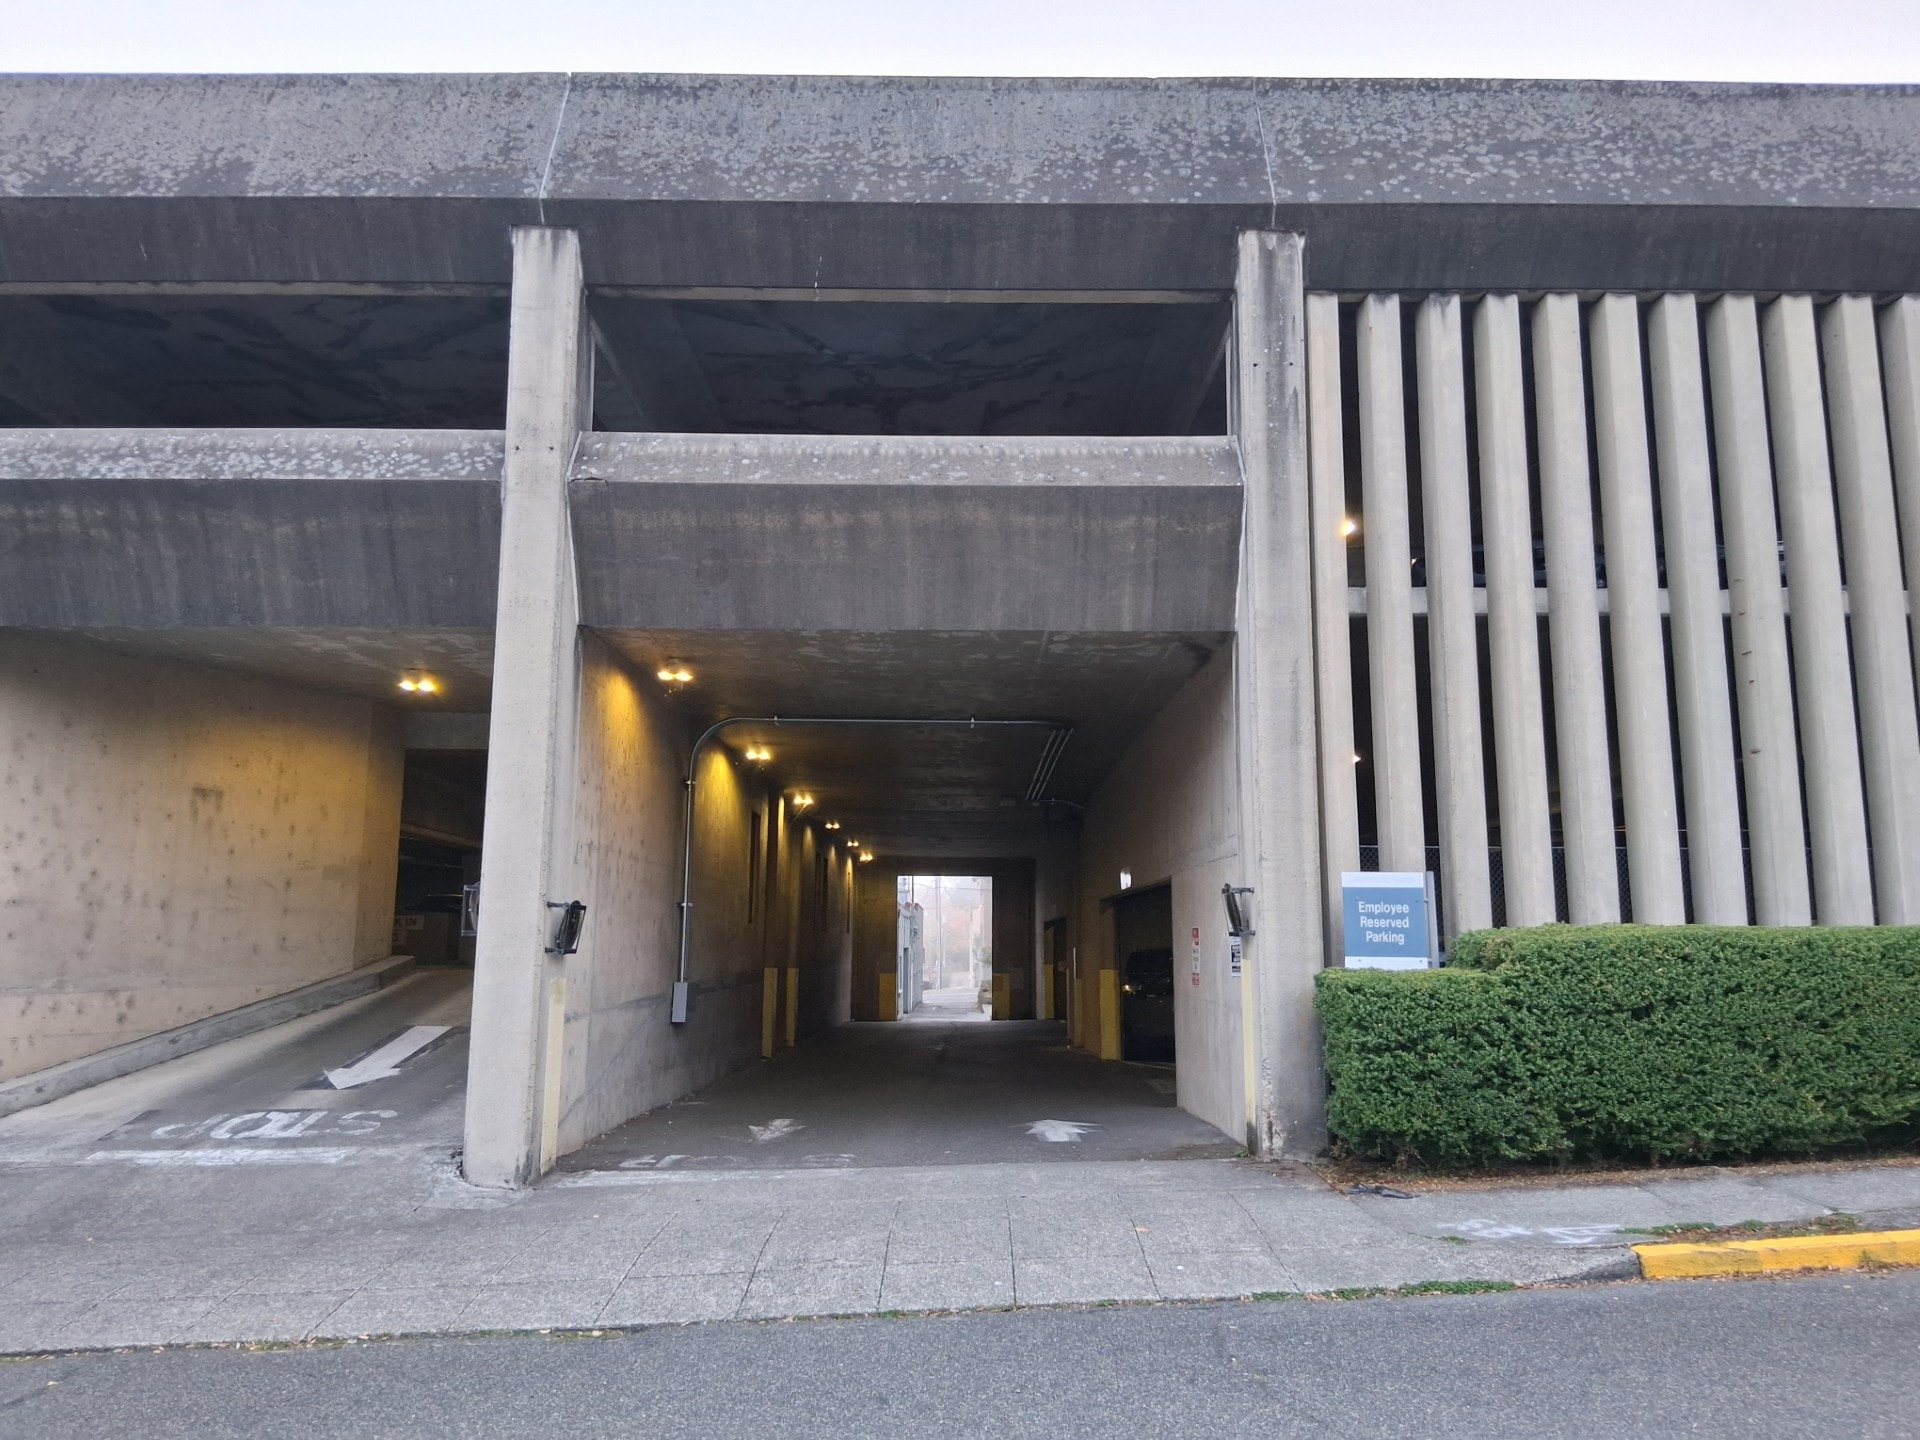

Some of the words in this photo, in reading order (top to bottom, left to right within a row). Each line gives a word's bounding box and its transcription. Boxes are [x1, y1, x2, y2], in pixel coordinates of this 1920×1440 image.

[1358, 901, 1409, 915] Employee
[1360, 916, 1409, 928] Reserved
[1366, 931, 1405, 946] Parking
[150, 1109, 399, 1140] STOP
